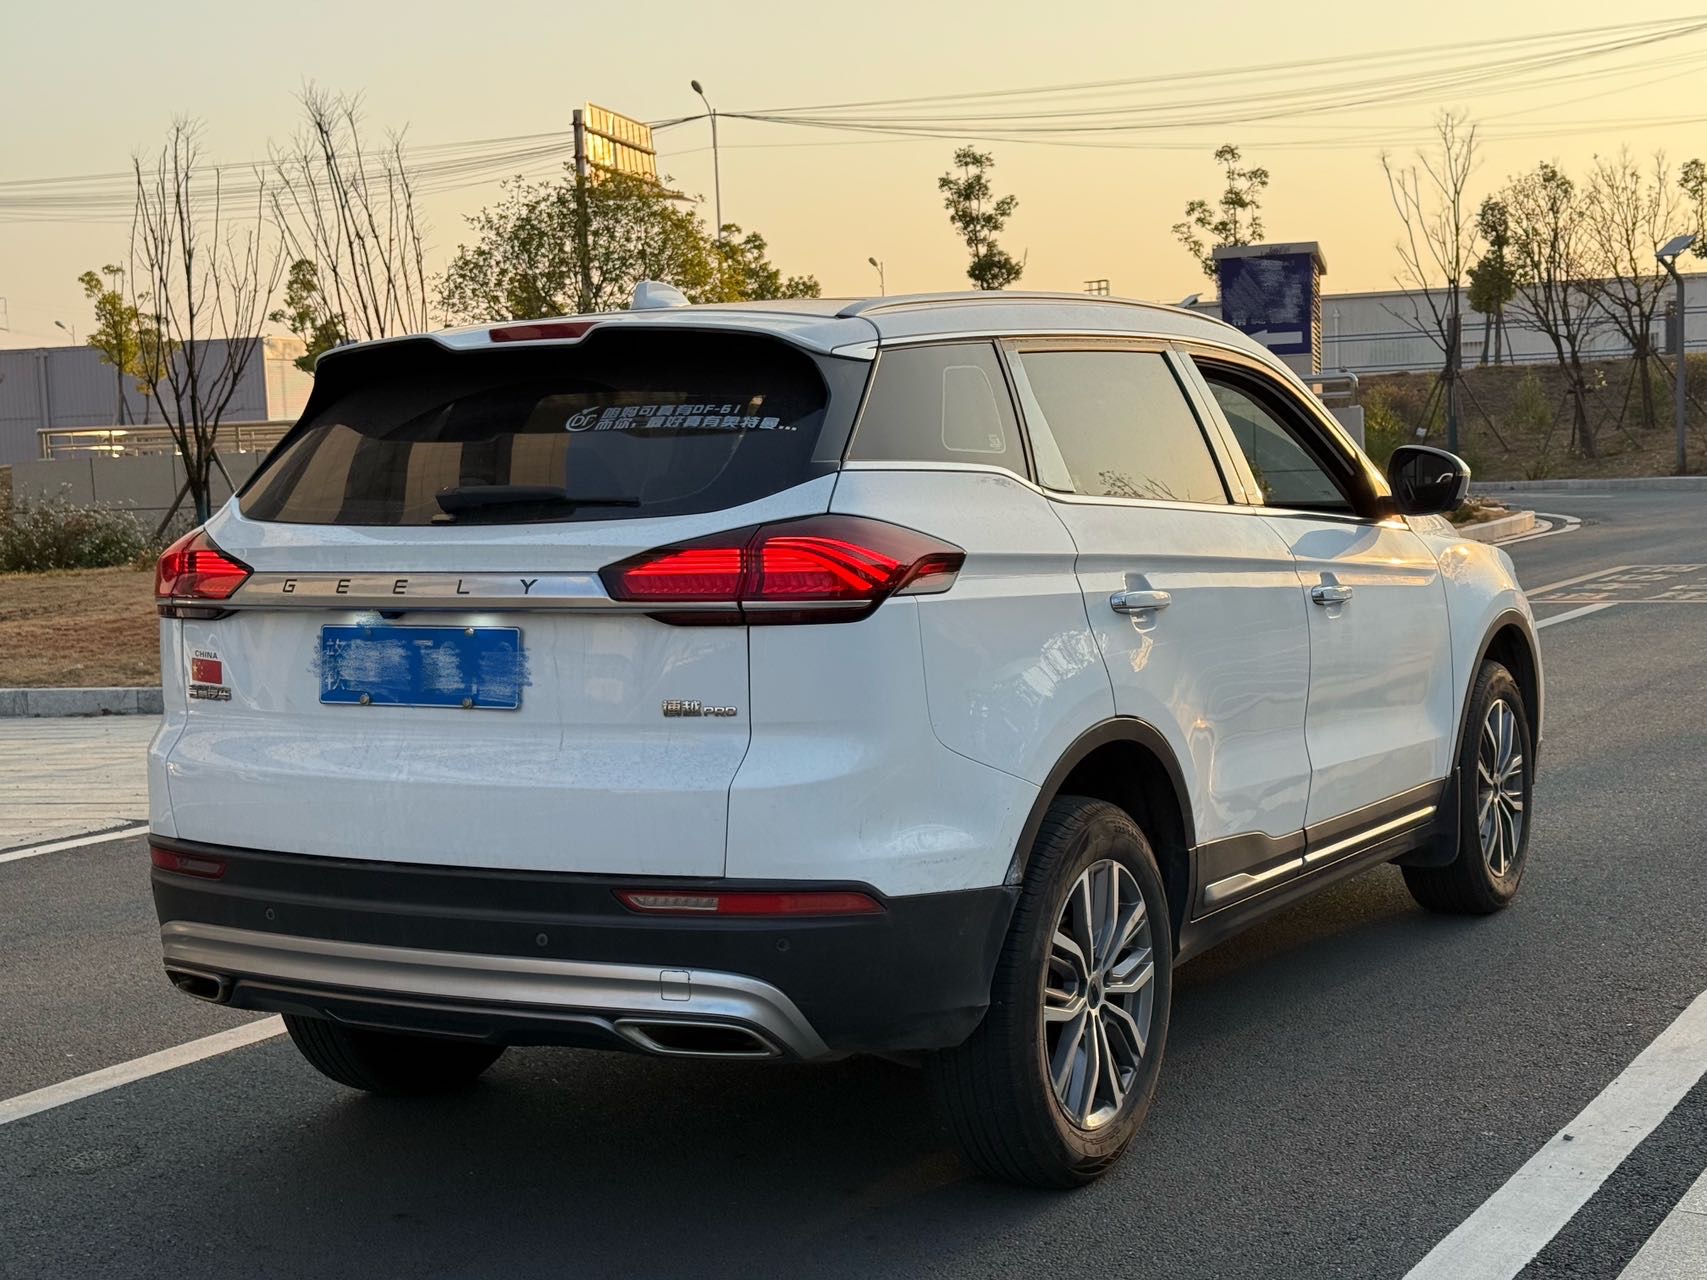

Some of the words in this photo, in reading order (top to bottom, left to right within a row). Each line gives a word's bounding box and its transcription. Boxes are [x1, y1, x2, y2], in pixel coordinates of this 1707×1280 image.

[282, 578, 538, 595] GEELY
[194, 650, 218, 659] CHINA
[703, 706, 738, 717] PRO
